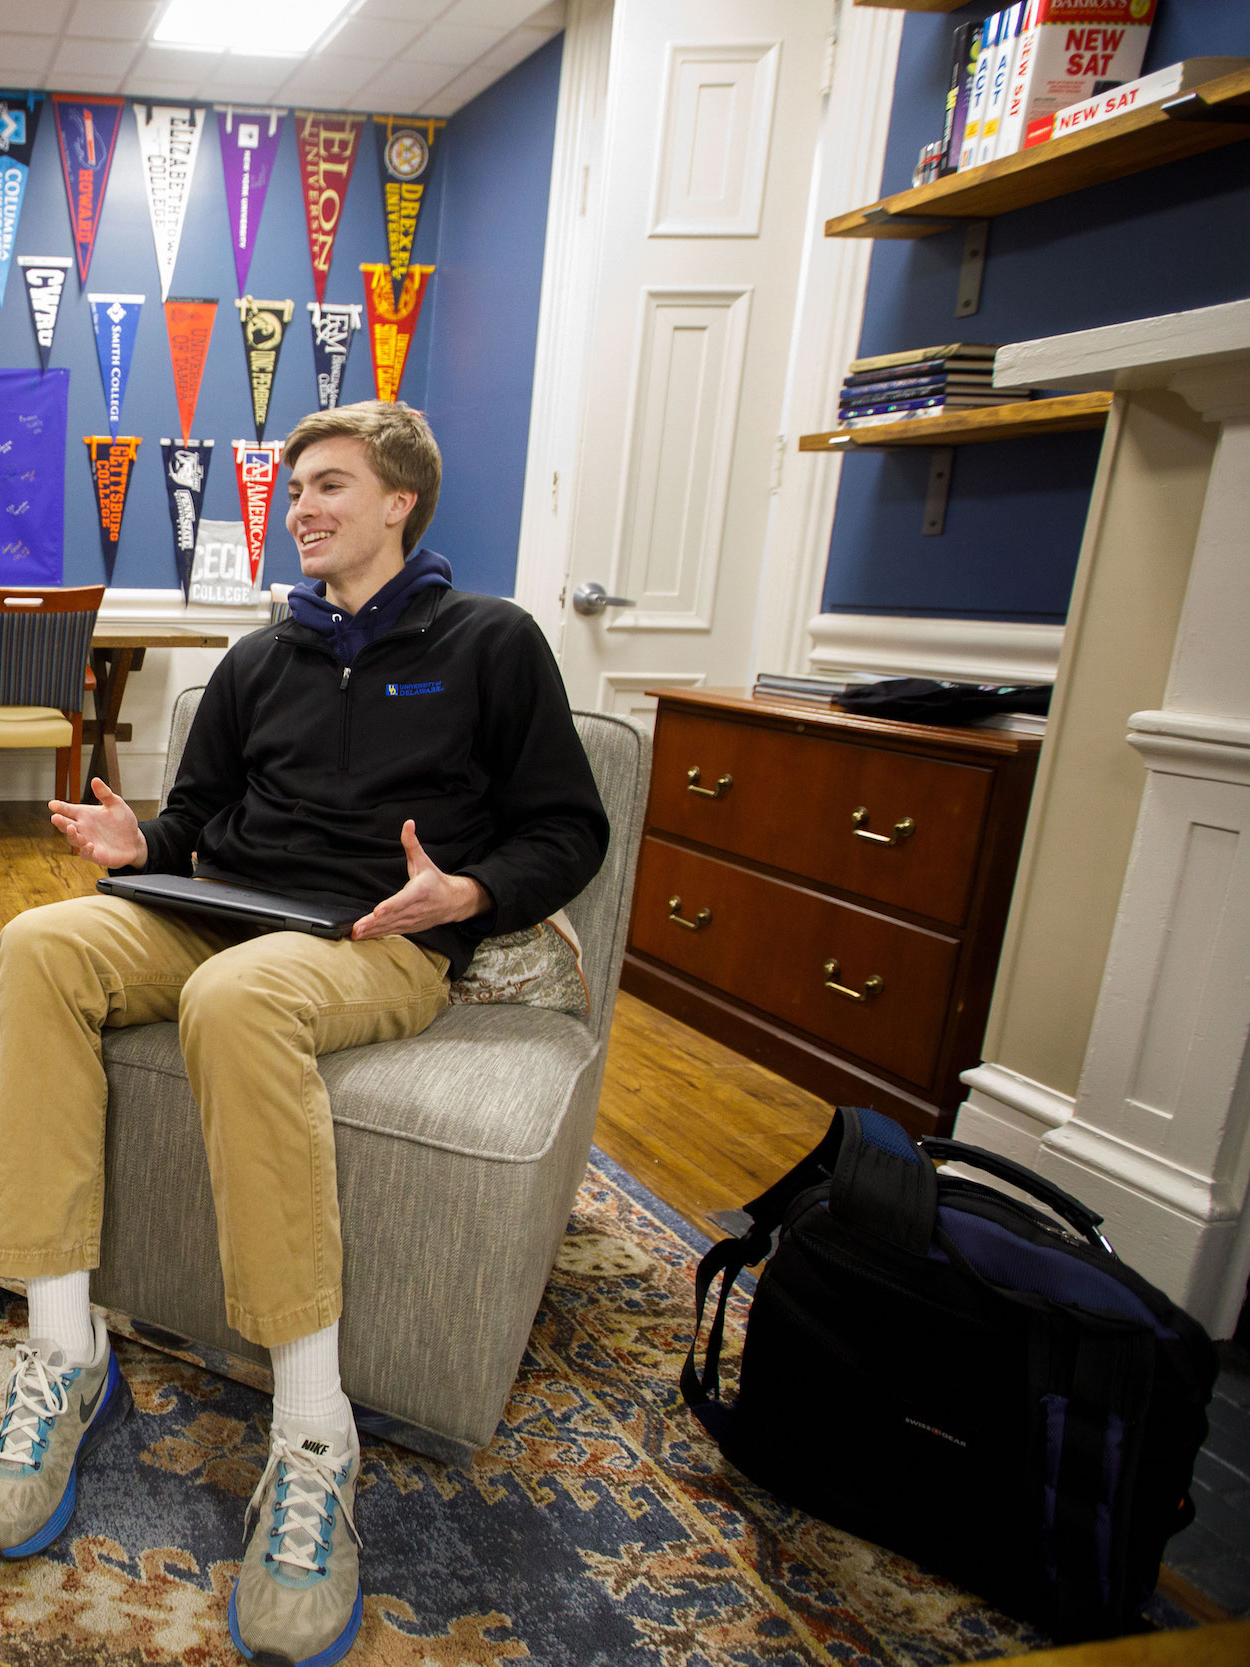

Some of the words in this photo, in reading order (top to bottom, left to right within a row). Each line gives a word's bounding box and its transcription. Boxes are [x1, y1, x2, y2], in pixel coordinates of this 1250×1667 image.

[1065, 29, 1126, 52] NEW
[1066, 53, 1114, 76] SAT
[975, 58, 988, 107] ACT
[993, 54, 1006, 105] ACT
[1059, 104, 1099, 131] NEW
[1104, 88, 1141, 113] SAT
[241, 172, 250, 197] YORK
[243, 150, 251, 171] NEW
[1, 168, 22, 260] COLUMBIA
[77, 168, 94, 243] HOWARD
[147, 154, 167, 228] COLLEGE
[167, 115, 196, 266] ELIZABETHTOWN
[303, 126, 321, 270] UNIVERSITY
[316, 123, 357, 272] ELON
[239, 197, 248, 249] UNIVERSITY
[399, 182, 424, 275] DREXEL
[25, 268, 65, 348] CWRU
[111, 325, 122, 365] SMITH
[172, 334, 189, 356] OF
[189, 328, 208, 410] UNIVERSITY
[110, 367, 121, 422] COLLEGE
[175, 356, 189, 402] TAMPA
[252, 373, 272, 425] PEMBROKE
[96, 460, 113, 528] COLLEGE
[109, 446, 130, 542] GETTYSBURG
[247, 483, 267, 561] AMERICAN
[193, 584, 250, 602] COLLEGE
[400, 681, 434, 690] UNIVERSITY
